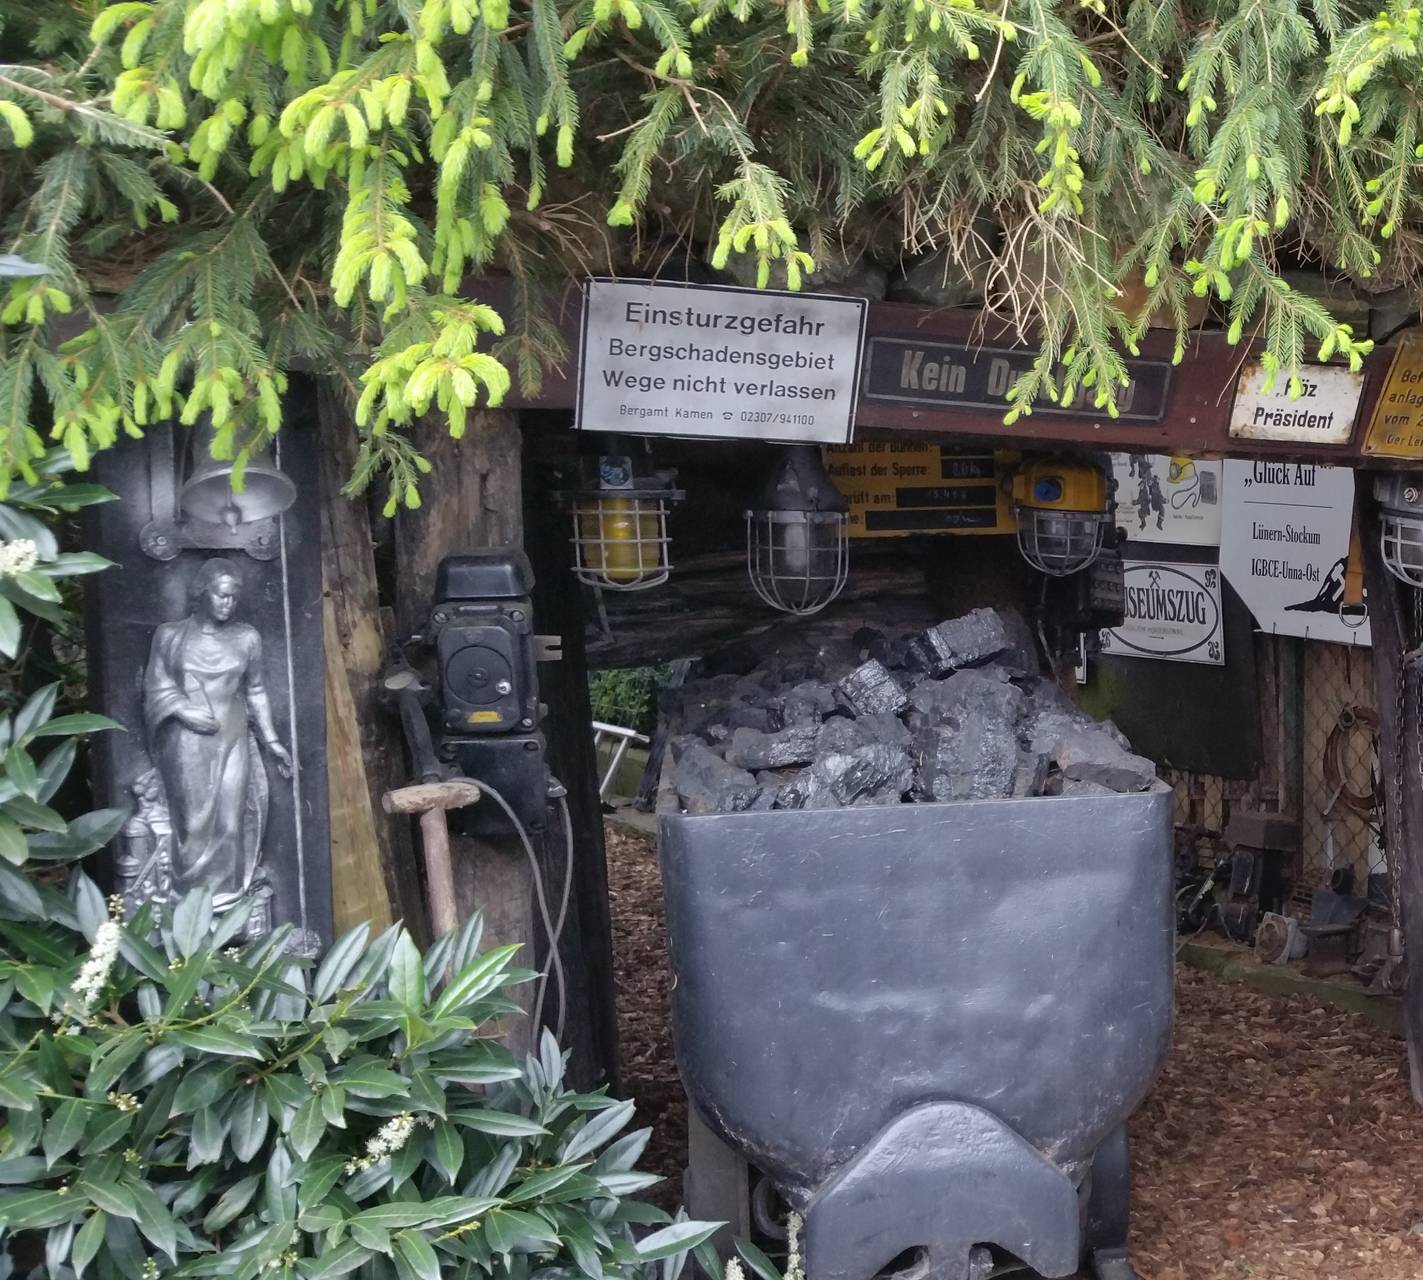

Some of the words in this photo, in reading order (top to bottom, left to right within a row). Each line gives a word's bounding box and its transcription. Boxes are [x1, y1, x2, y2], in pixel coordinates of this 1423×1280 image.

[625, 301, 826, 337] Einsturzgefahr
[608, 337, 835, 371] Bergschadensgebiet
[900, 350, 967, 393] Kein
[602, 369, 666, 393] Wege
[673, 374, 727, 395] nicht
[733, 378, 837, 401] verlassen
[619, 404, 669, 419] Bergamt
[674, 406, 714, 421] Kamen
[740, 410, 815, 426] 02307/941100
[1253, 406, 1334, 429] Präsident
[1384, 413, 1410, 426] vom
[1252, 521, 1321, 545] Lünern-Stockum
[1251, 558, 1320, 582] IGBCE-Unna-Ost
